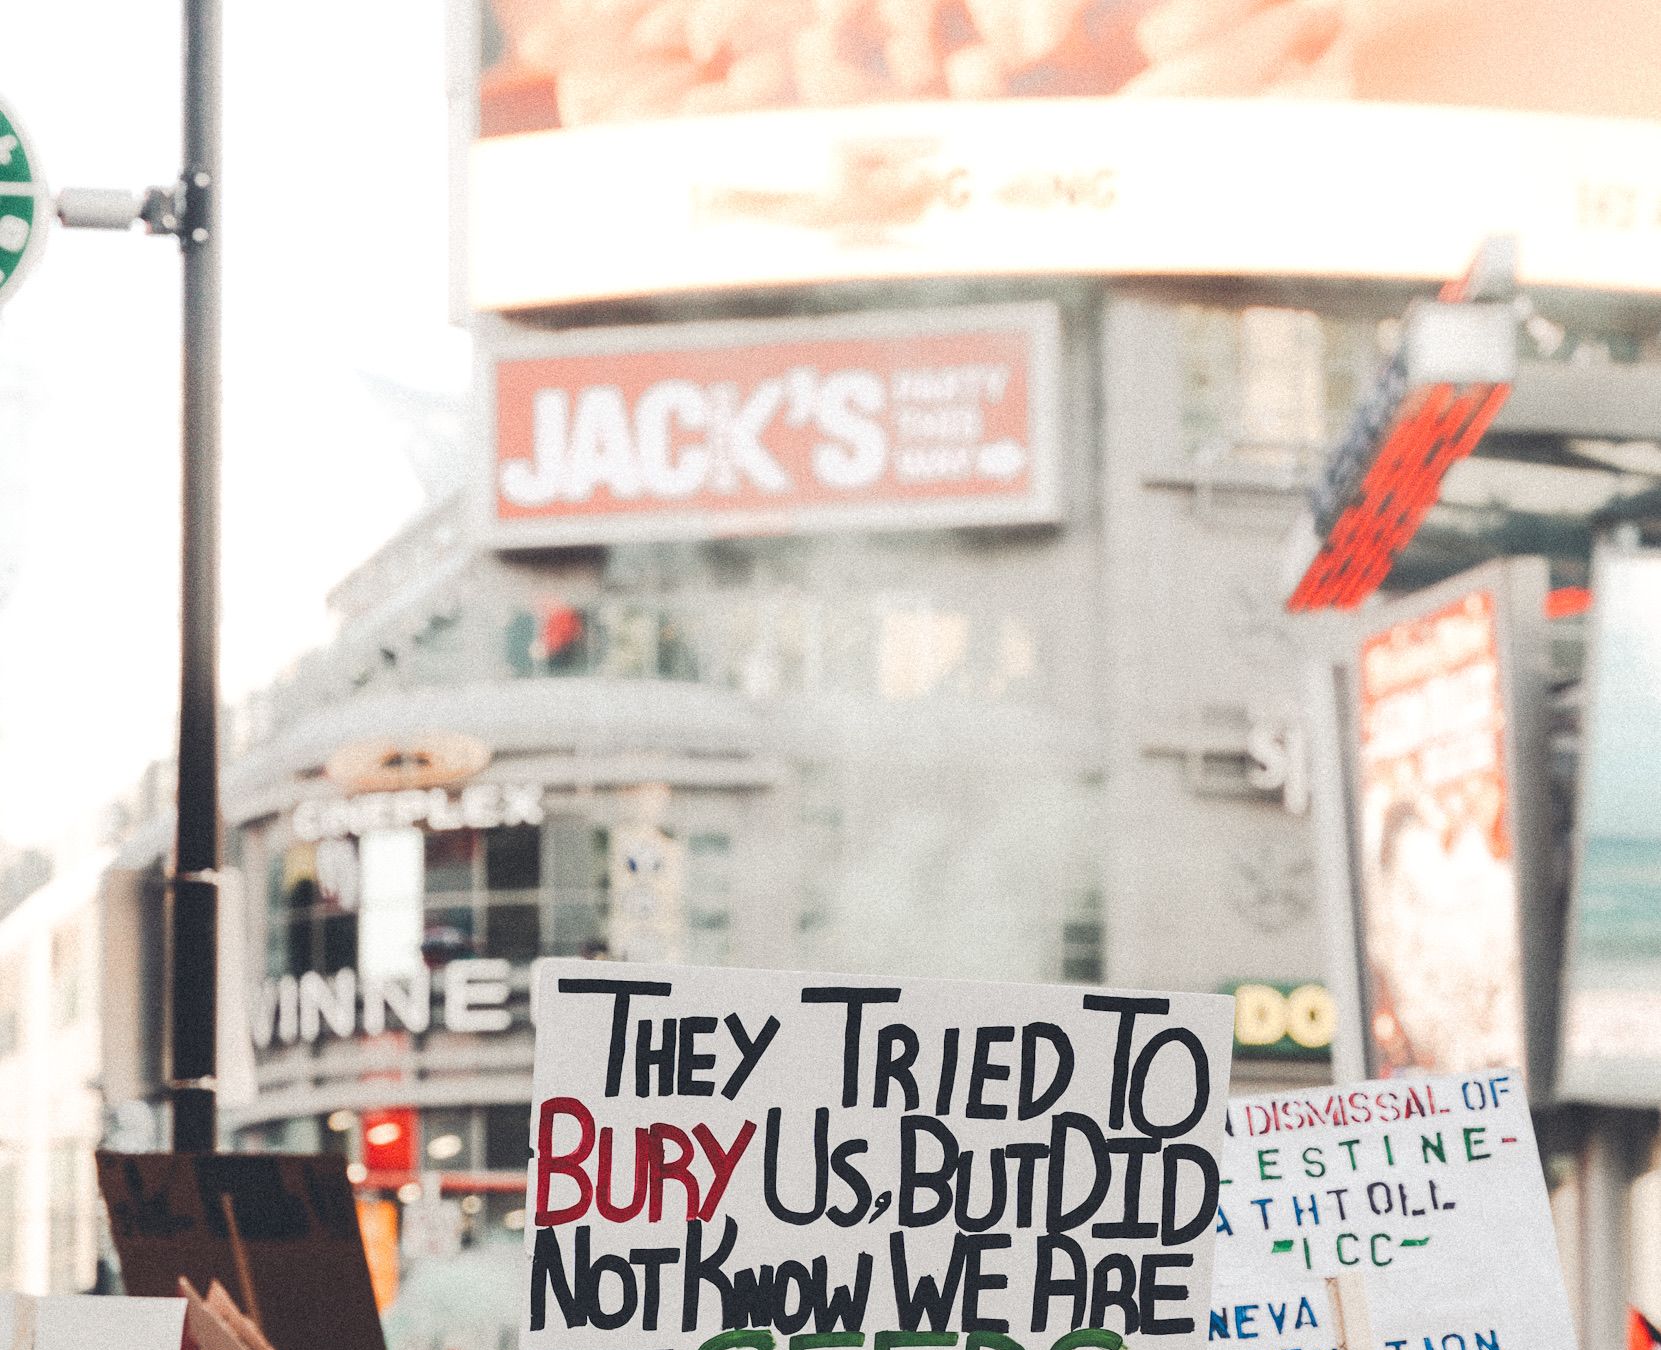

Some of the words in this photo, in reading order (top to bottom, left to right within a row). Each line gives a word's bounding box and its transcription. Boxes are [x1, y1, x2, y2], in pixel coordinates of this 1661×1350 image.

[500, 366, 887, 507] JACK'S
[250, 958, 540, 1046] INNE
[558, 979, 780, 1100] THEY
[801, 988, 1075, 1120] TRIED
[1084, 994, 1210, 1138] TO
[1246, 1086, 1451, 1139] DISMISSAL
[1462, 1077, 1510, 1110] OF
[535, 1097, 757, 1227] BURY
[1220, 1127, 1517, 1185] ESTINE-
[530, 1225, 680, 1331] NOT
[890, 1231, 1012, 1333] WE
[1030, 1232, 1195, 1335] ARE
